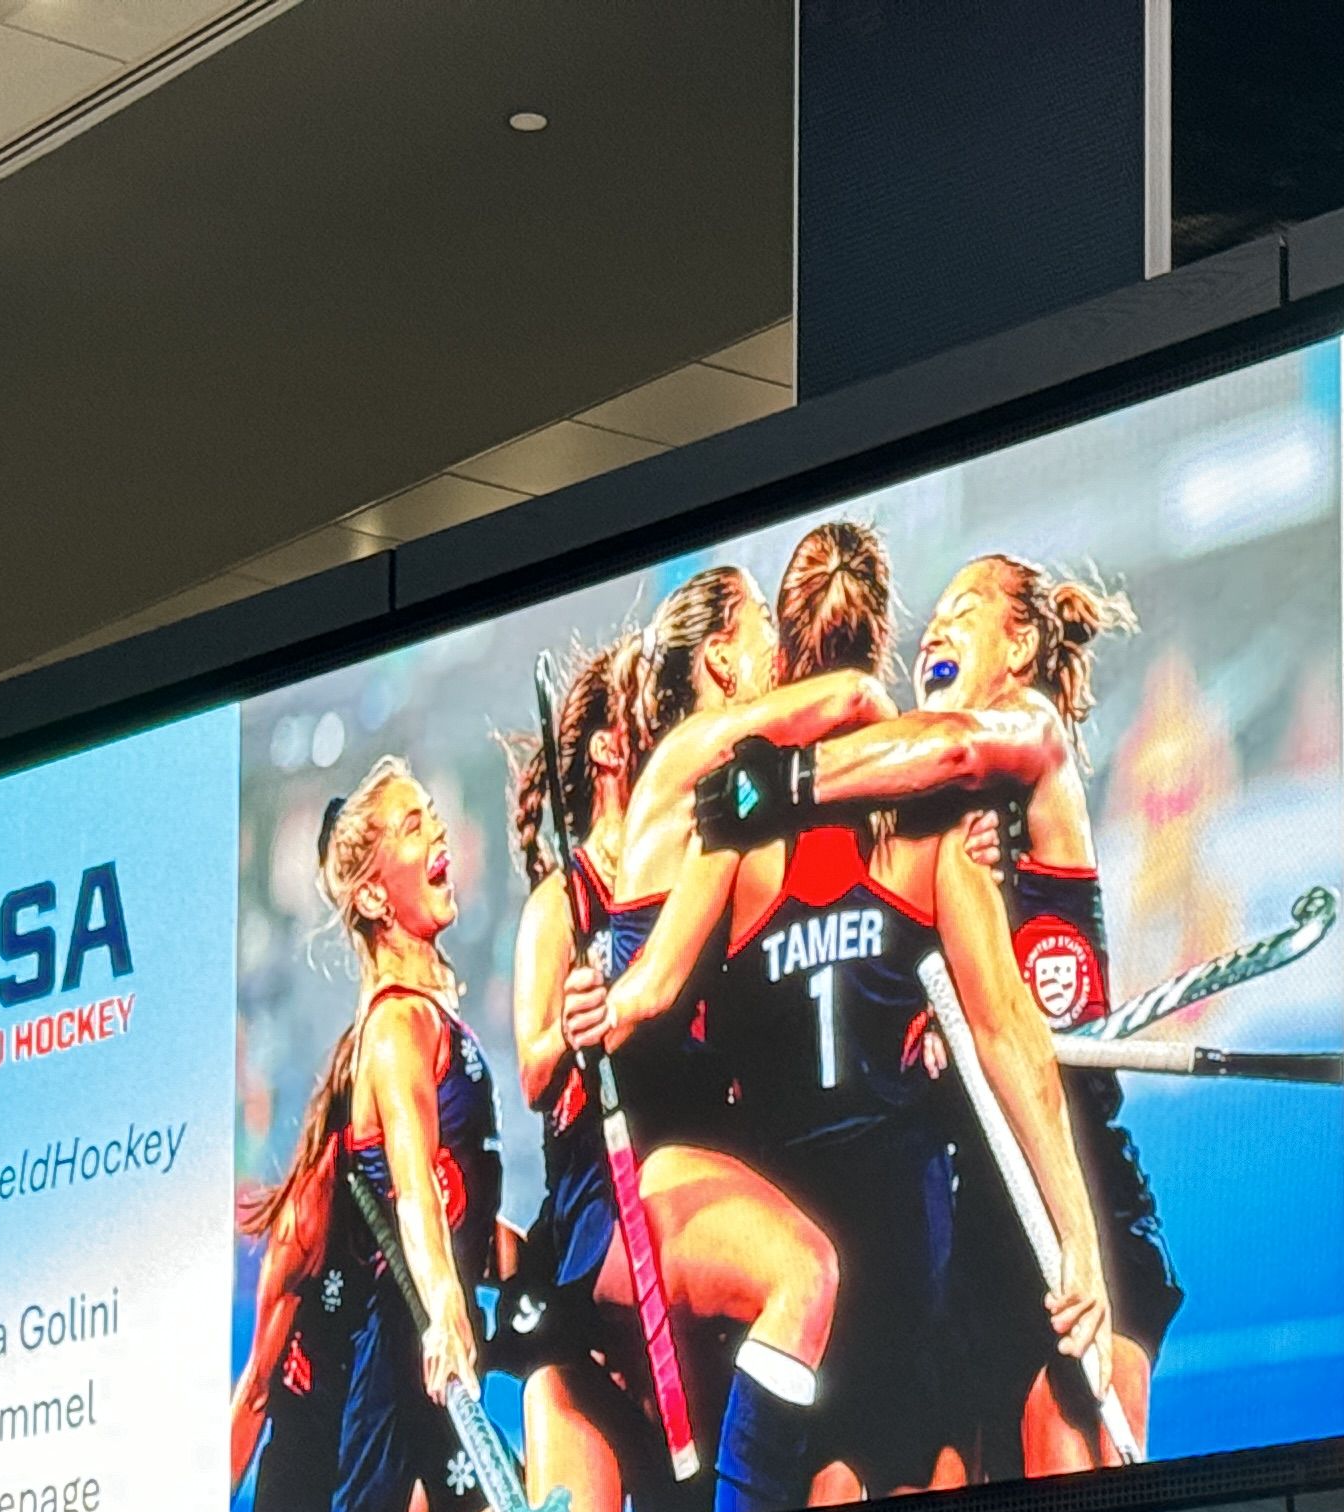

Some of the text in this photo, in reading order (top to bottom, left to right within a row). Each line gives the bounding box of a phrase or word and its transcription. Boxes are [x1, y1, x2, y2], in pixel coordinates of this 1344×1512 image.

[761, 908, 884, 984] TAMER
[12, 993, 136, 1061] HOCKEY
[809, 964, 836, 1090] 1
[19, 1286, 119, 1351] Golini
